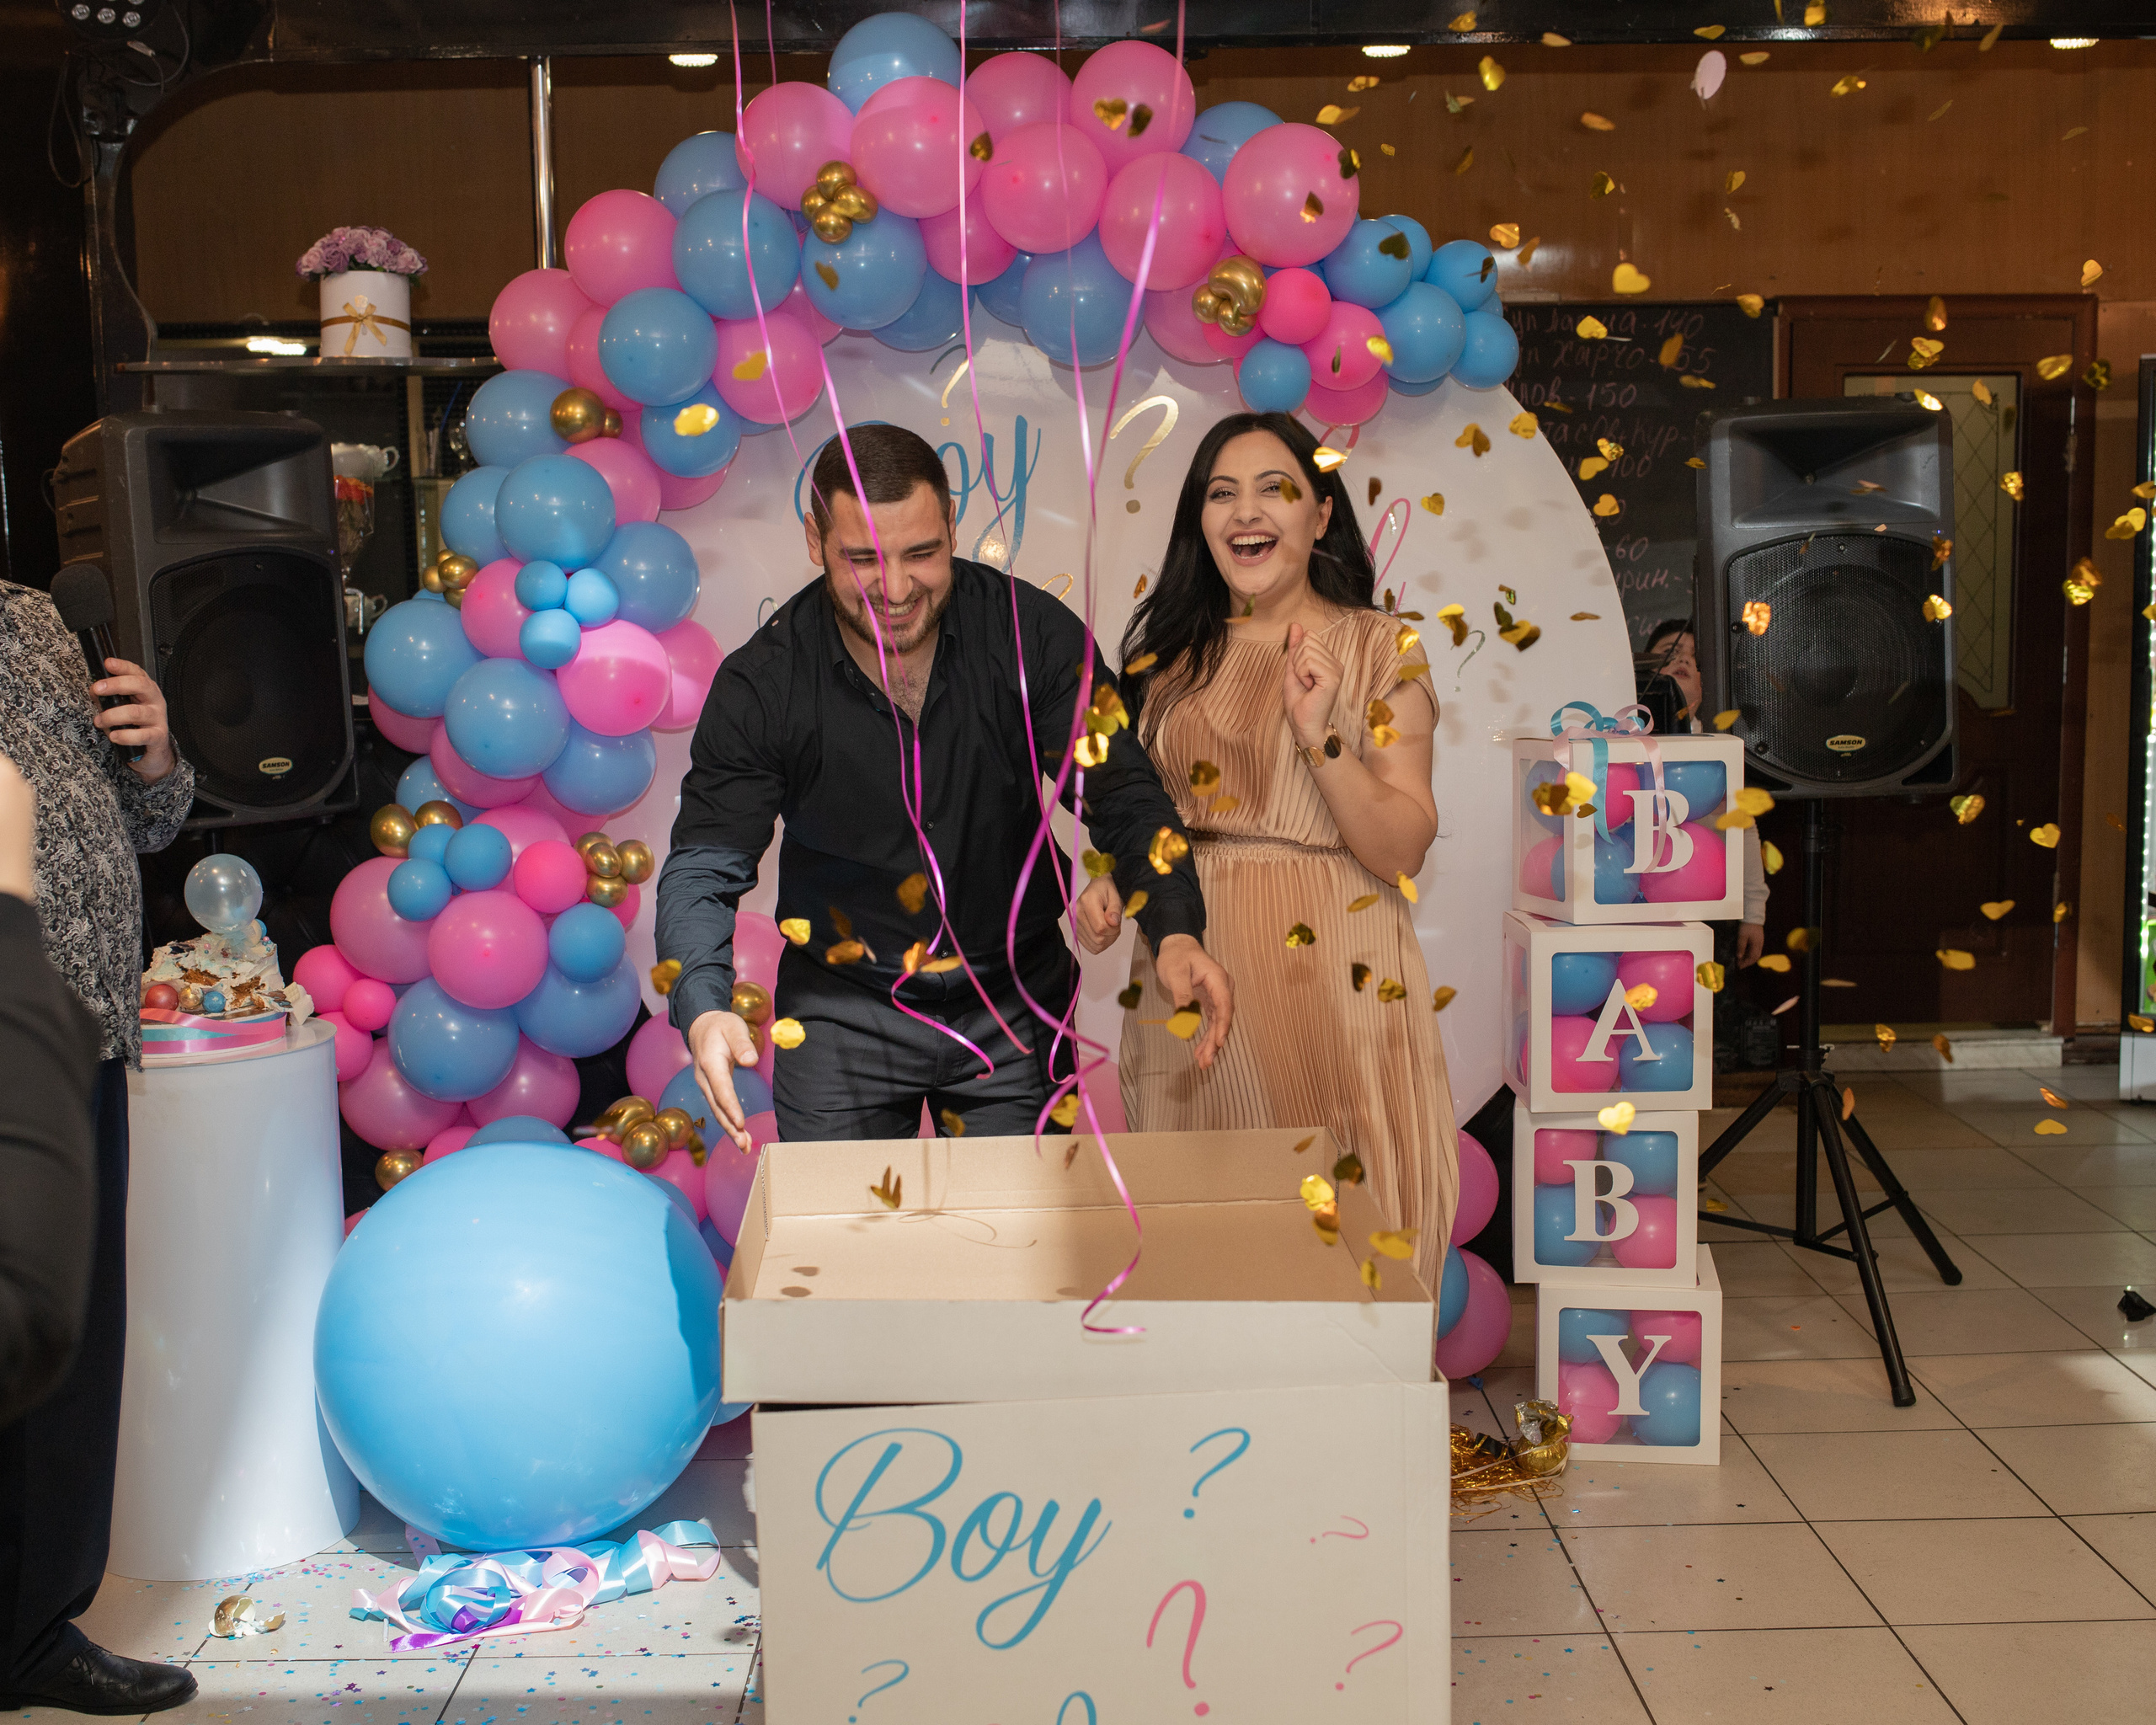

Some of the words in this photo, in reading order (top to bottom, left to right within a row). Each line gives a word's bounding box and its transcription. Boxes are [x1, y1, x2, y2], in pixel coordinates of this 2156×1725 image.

[1654, 308, 1705, 339] 140
[1662, 344, 1717, 375] 55
[1586, 382, 1638, 411] 150
[1614, 532, 1649, 563] 60
[815, 1427, 1113, 1651] Boy
